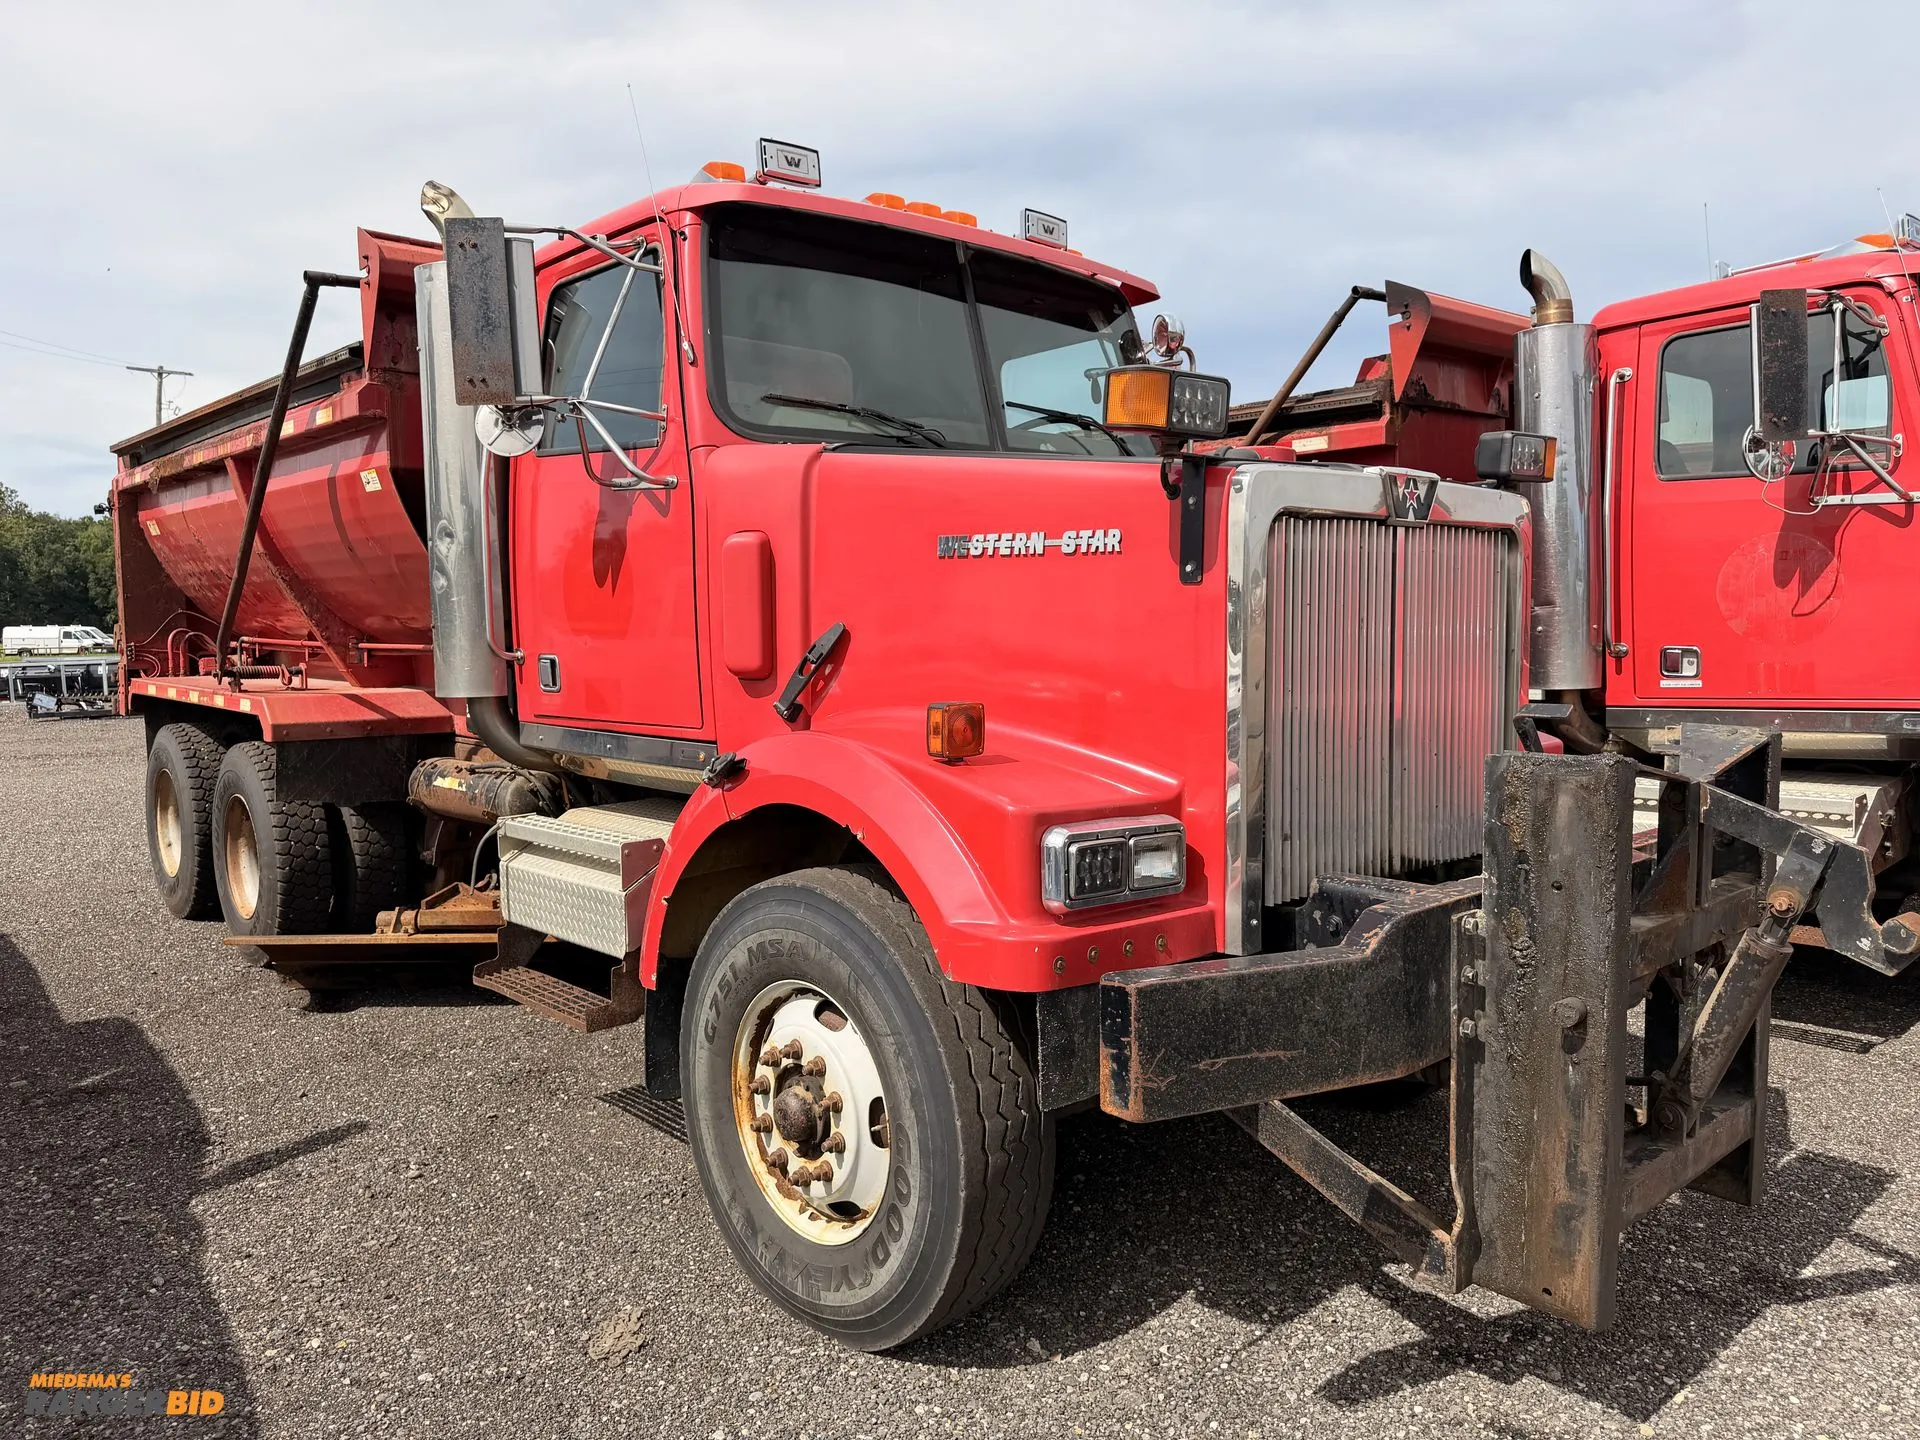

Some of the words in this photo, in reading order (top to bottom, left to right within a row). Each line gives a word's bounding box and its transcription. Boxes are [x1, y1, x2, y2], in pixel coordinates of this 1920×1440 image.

[937, 533, 1045, 559] WESTERN
[1061, 528, 1122, 556] STAR
[746, 938, 806, 968] MSA
